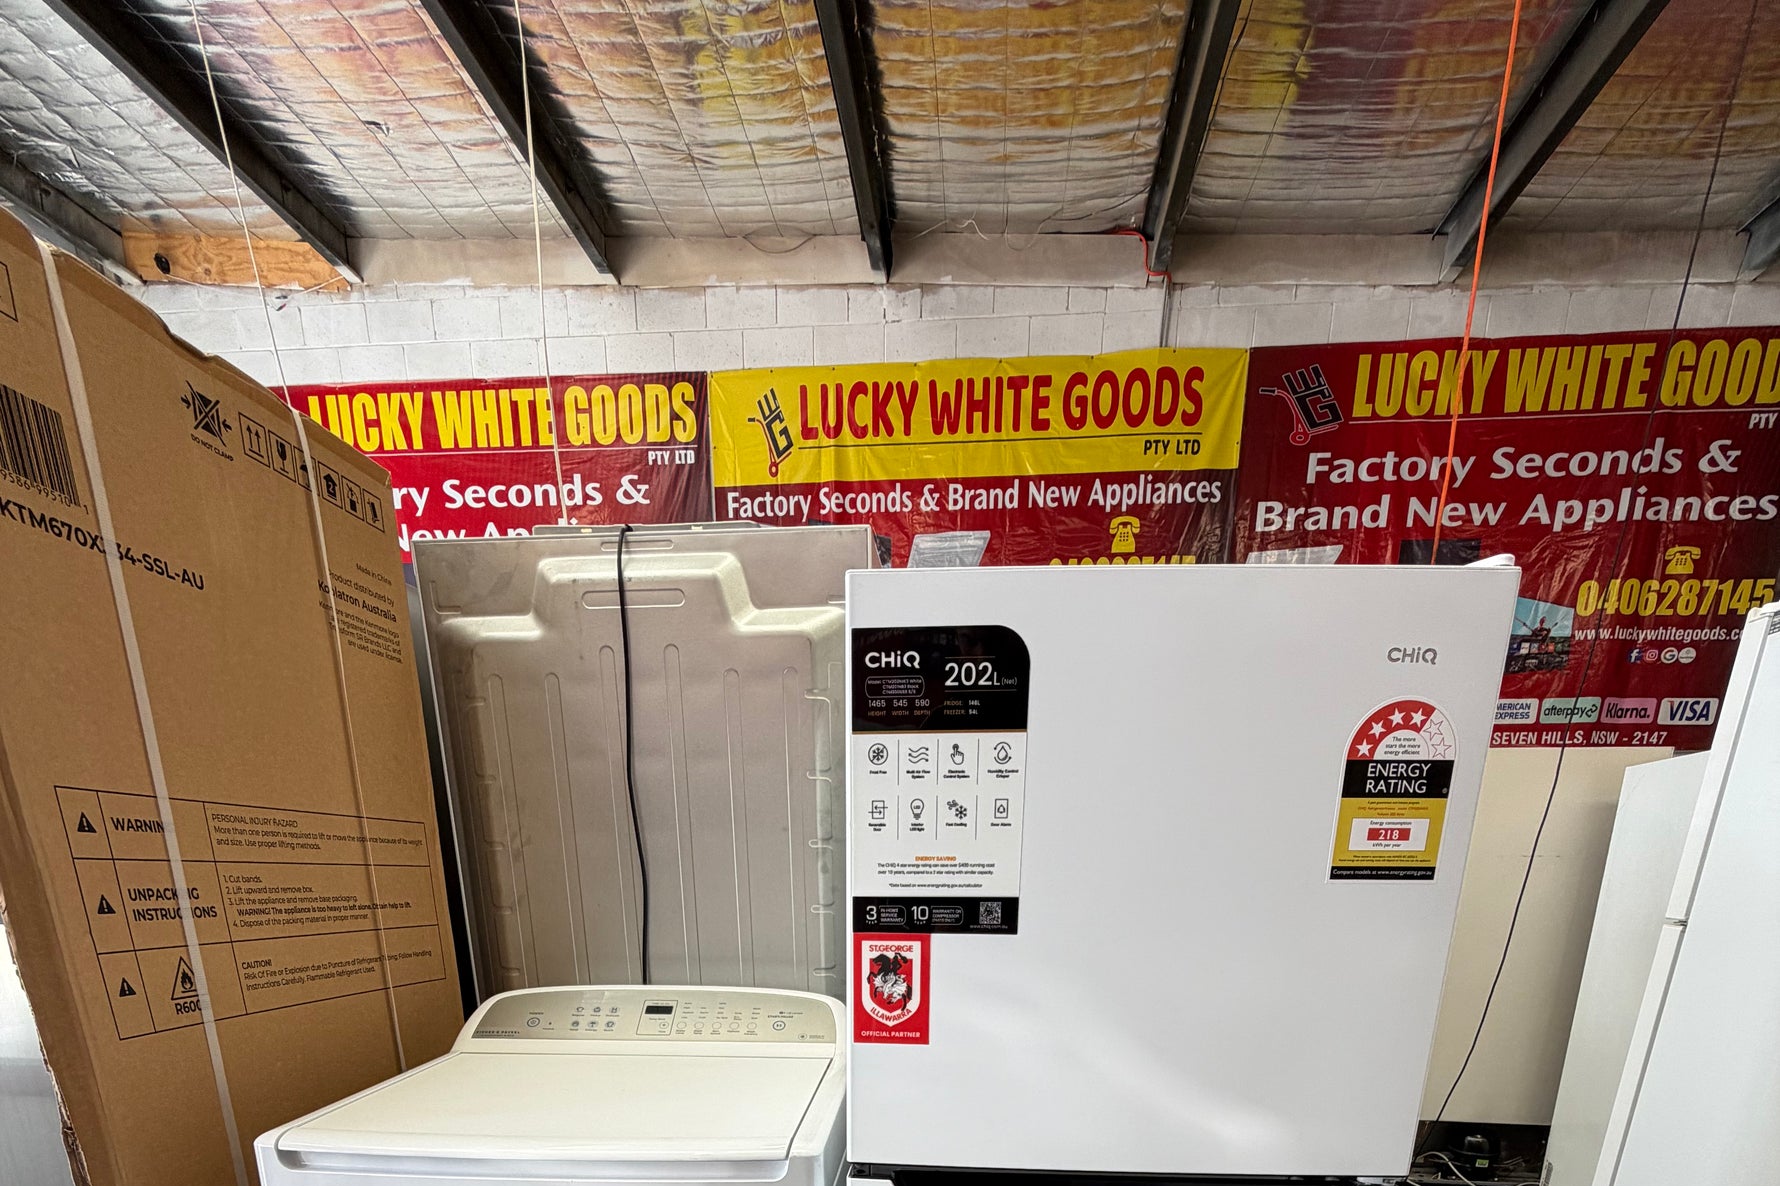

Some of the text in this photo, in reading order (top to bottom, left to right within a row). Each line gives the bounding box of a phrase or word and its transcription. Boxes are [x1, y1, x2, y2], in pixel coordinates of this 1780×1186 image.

[1352, 338, 1780, 419] LUCKY WHITE GOOD
[800, 365, 1205, 442] LUCKY WHITE GOODS
[432, 386, 554, 449] WHITE
[564, 381, 697, 447] GOODS
[1748, 412, 1778, 430] PTY
[191, 433, 234, 462] DO NOT CLAMP
[1143, 437, 1200, 457] PTY LTD
[648, 449, 694, 466] PTY LTD
[1306, 437, 1741, 488] Factory Seconds &
[445, 473, 603, 509] Seconds
[616, 474, 651, 505] &
[727, 474, 1222, 522] Factory Seconds & Brand New Appliances
[1255, 486, 1779, 533] Brand New Appliances
[0, 496, 205, 590] KTM670X34-SSL-AU
[356, 562, 393, 586] Made China
[317, 579, 397, 623] Kolatron Australia
[353, 581, 395, 607] distributed by
[1575, 578, 1775, 617] 0406287145
[864, 650, 921, 669] CHiQ
[1387, 646, 1438, 665] CHiQ
[1001, 677, 1018, 686] (Net)
[868, 698, 930, 708] 1465 545 590
[1495, 700, 1711, 722] EXPRESS afterpay Klarna. VISA
[1496, 702, 1532, 711] MERICAN
[1492, 732, 1538, 745] SEVEN
[1541, 730, 1587, 746] HILLS,
[1590, 731, 1620, 745] NSW
[1631, 731, 1668, 745] 2147
[1367, 763, 1432, 777] ENERGY
[1365, 779, 1427, 794] RATING
[110, 816, 165, 834] WARNIN
[211, 813, 249, 825] PERSONAL
[213, 825, 231, 835] More
[232, 826, 248, 835] than
[248, 829, 260, 837] one
[261, 830, 282, 838] person
[1378, 829, 1399, 840] 218
[216, 837, 229, 846] and
[245, 838, 256, 847] Use
[257, 840, 277, 849] proper
[228, 874, 241, 883] Cut
[127, 887, 200, 902] UNPACKG
[232, 885, 243, 894] Lift
[244, 886, 267, 895] upward
[268, 886, 280, 894] and
[280, 886, 302, 894] remove
[246, 897, 257, 905] the
[257, 896, 286, 905] appliance
[286, 896, 298, 904] and
[133, 906, 218, 922] INSTRUCIONS
[236, 907, 271, 917] WARNING!
[271, 907, 283, 915] The
[866, 905, 877, 920] 3
[911, 905, 929, 920] 10
[239, 919, 264, 928] Dispose
[271, 917, 282, 925] the
[241, 958, 273, 970] CAUTION!
[243, 971, 257, 980] Risk
[266, 969, 277, 977] Fire
[311, 964, 321, 972] due
[870, 1006, 913, 1022] ILLAWARRA
